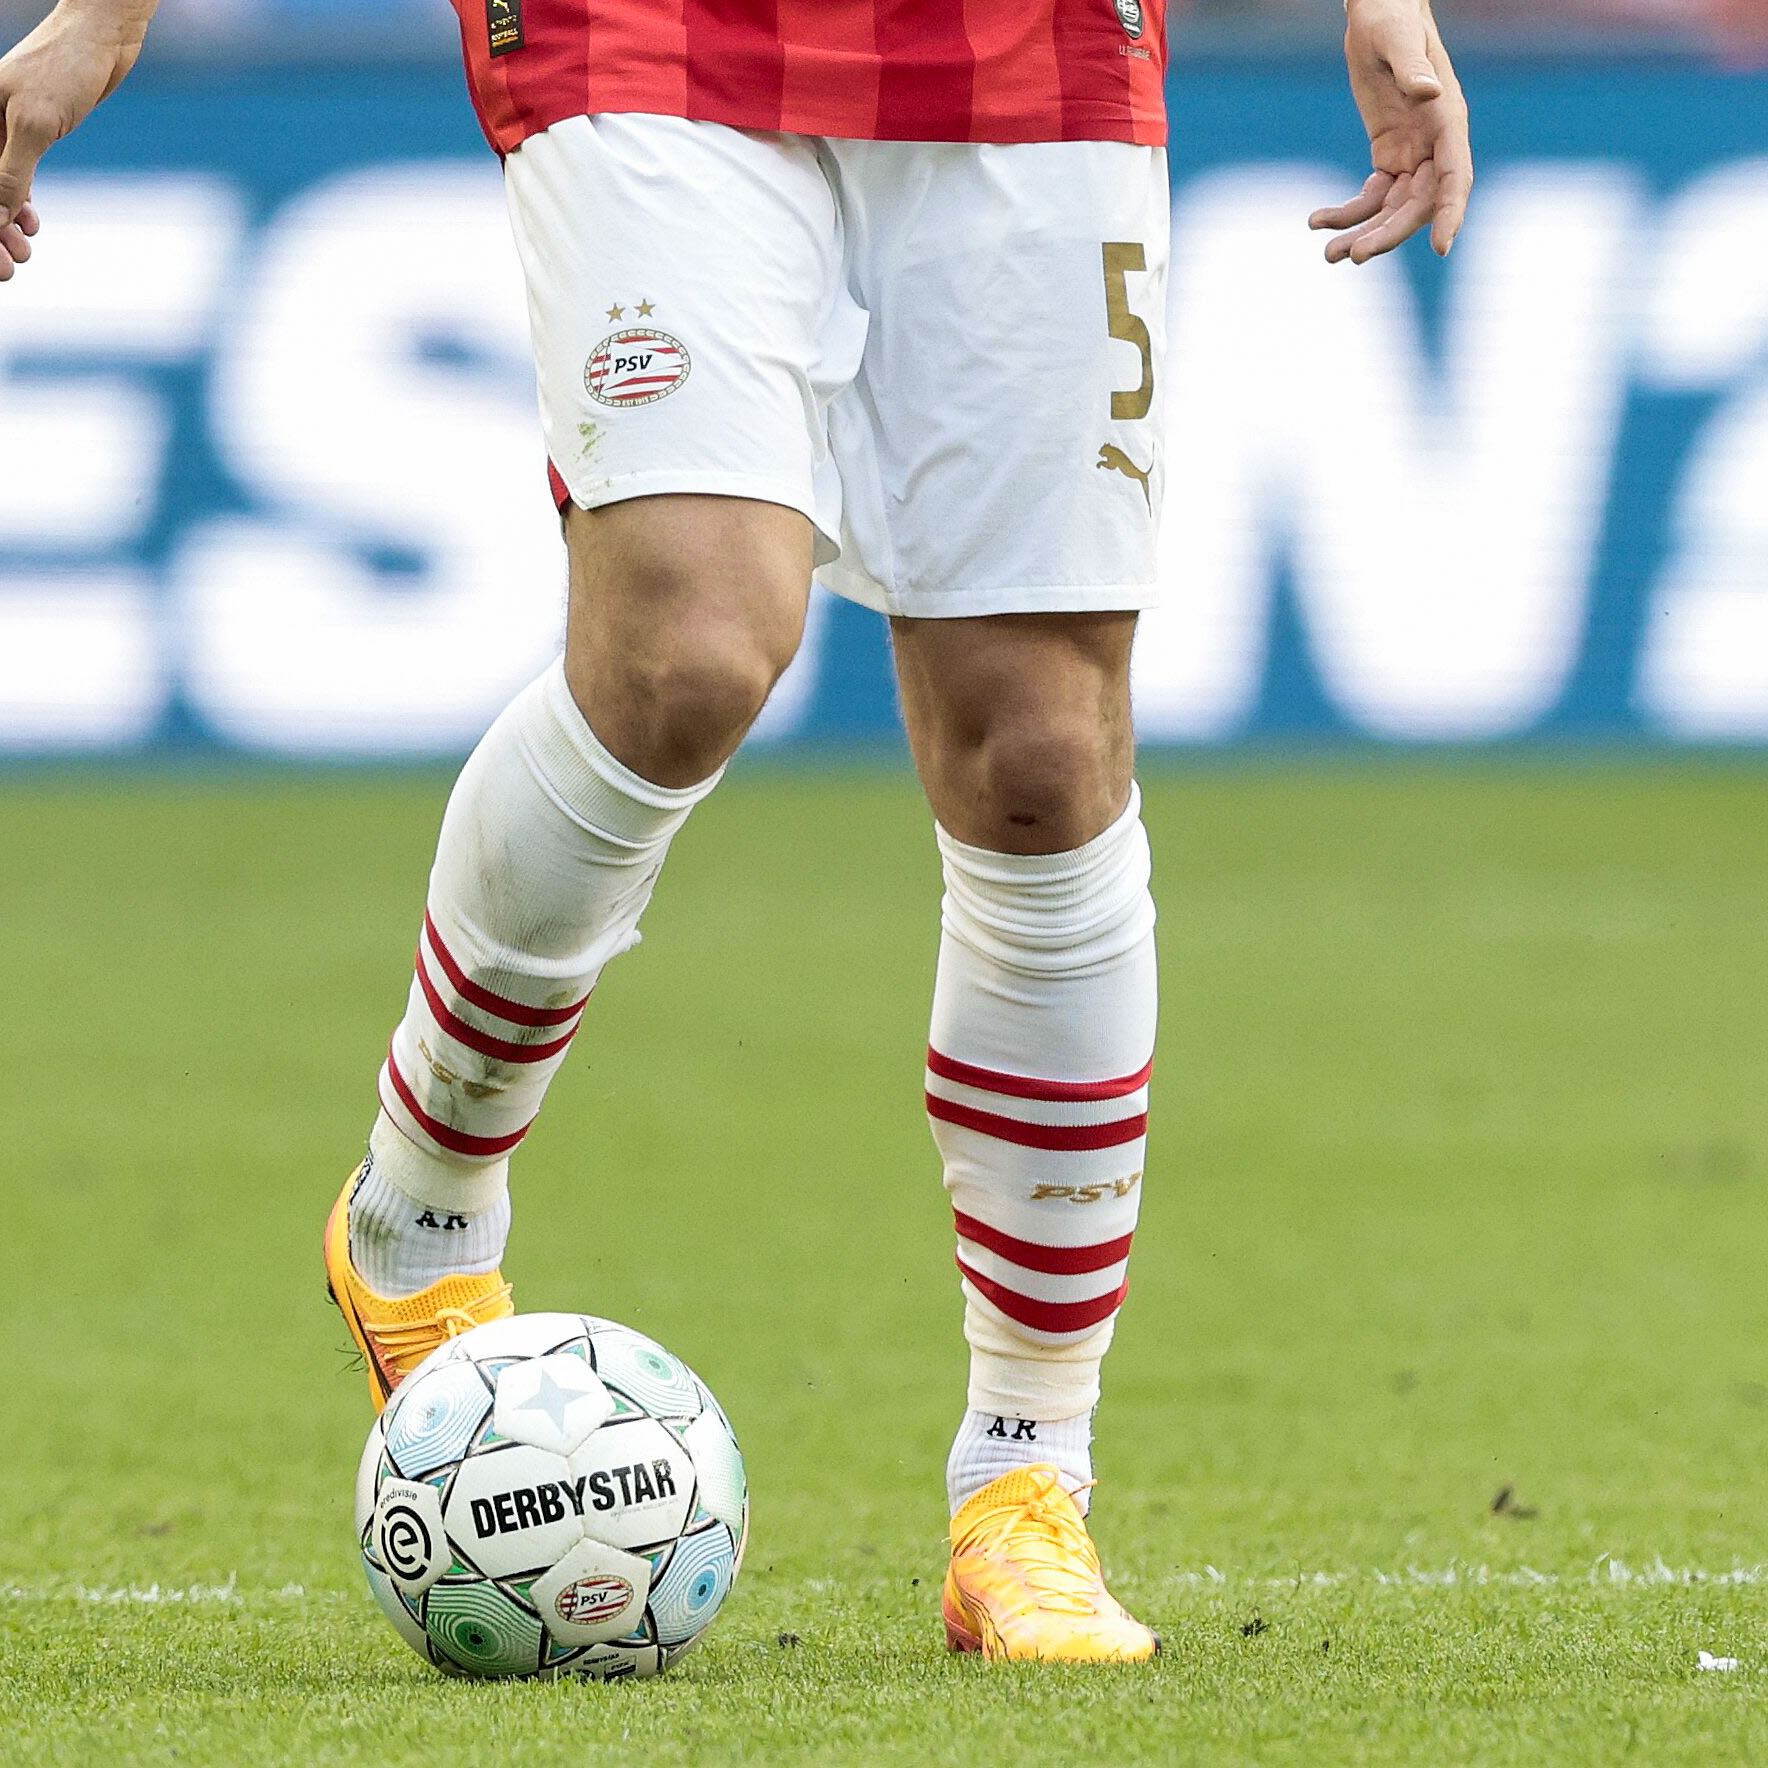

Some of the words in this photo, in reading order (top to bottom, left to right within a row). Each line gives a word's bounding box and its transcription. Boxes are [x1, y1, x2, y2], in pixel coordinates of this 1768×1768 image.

[1101, 241, 1155, 420] 5
[615, 355, 652, 374] PSV
[380, 1489, 418, 1509] eredivisie
[470, 1459, 676, 1538] DERBYSTAR
[580, 1591, 608, 1606] PSV
